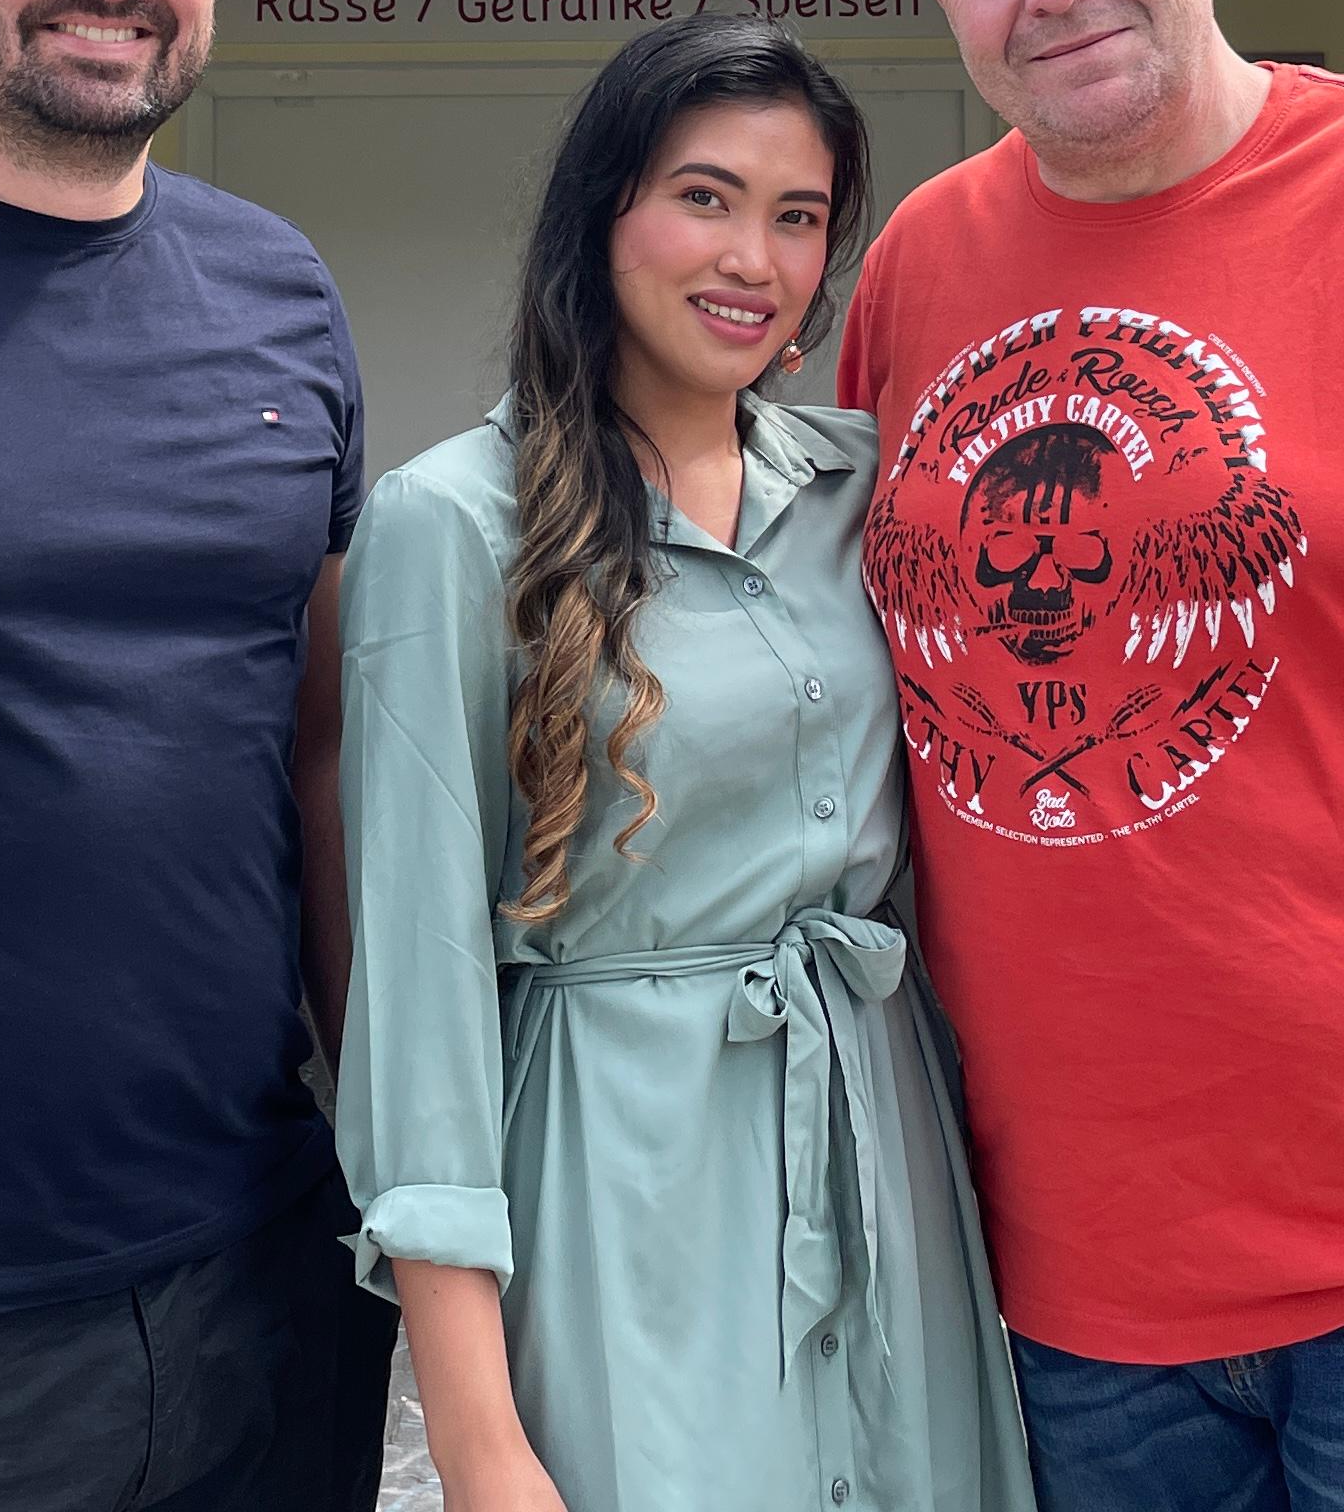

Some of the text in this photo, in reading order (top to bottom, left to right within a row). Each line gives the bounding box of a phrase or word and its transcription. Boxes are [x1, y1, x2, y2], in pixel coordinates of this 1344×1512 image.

[939, 360, 1052, 456] Rude
[1071, 347, 1200, 443] Rough
[947, 393, 1154, 486] FILTHY CARTEL
[1126, 656, 1279, 810] CARTEL
[995, 825, 1038, 844] SELECTION
[1110, 825, 1132, 838] THE
[1133, 813, 1163, 832] FILTHY
[1164, 793, 1200, 818] CARTEL
[1036, 788, 1070, 809] Bad
